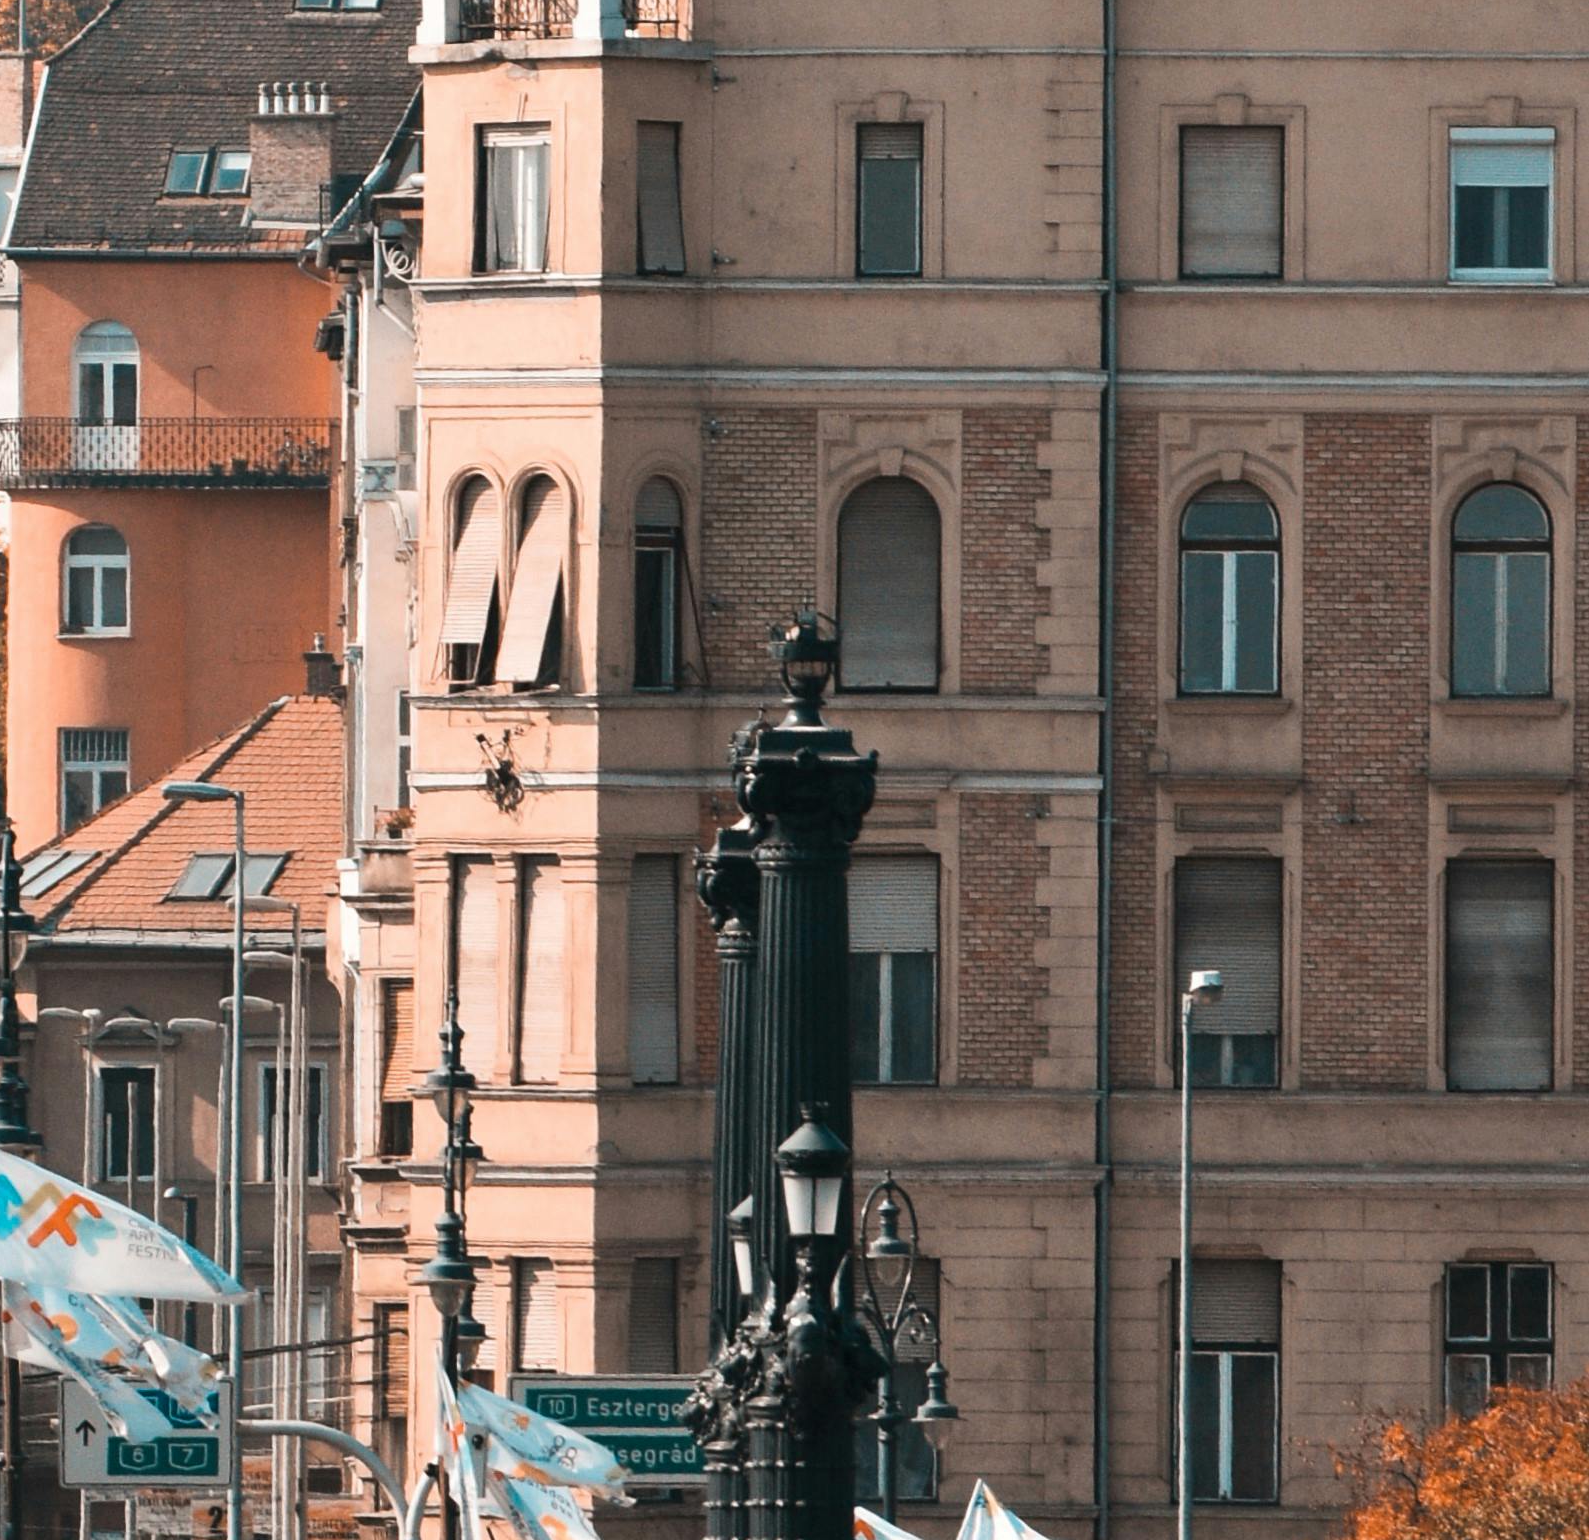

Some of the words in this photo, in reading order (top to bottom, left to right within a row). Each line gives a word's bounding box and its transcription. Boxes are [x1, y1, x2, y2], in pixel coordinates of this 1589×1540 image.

[548, 1399, 565, 1415] 10
[132, 1448, 144, 1463] 6
[181, 1448, 194, 1463] 7
[618, 1443, 696, 1467] segrád
